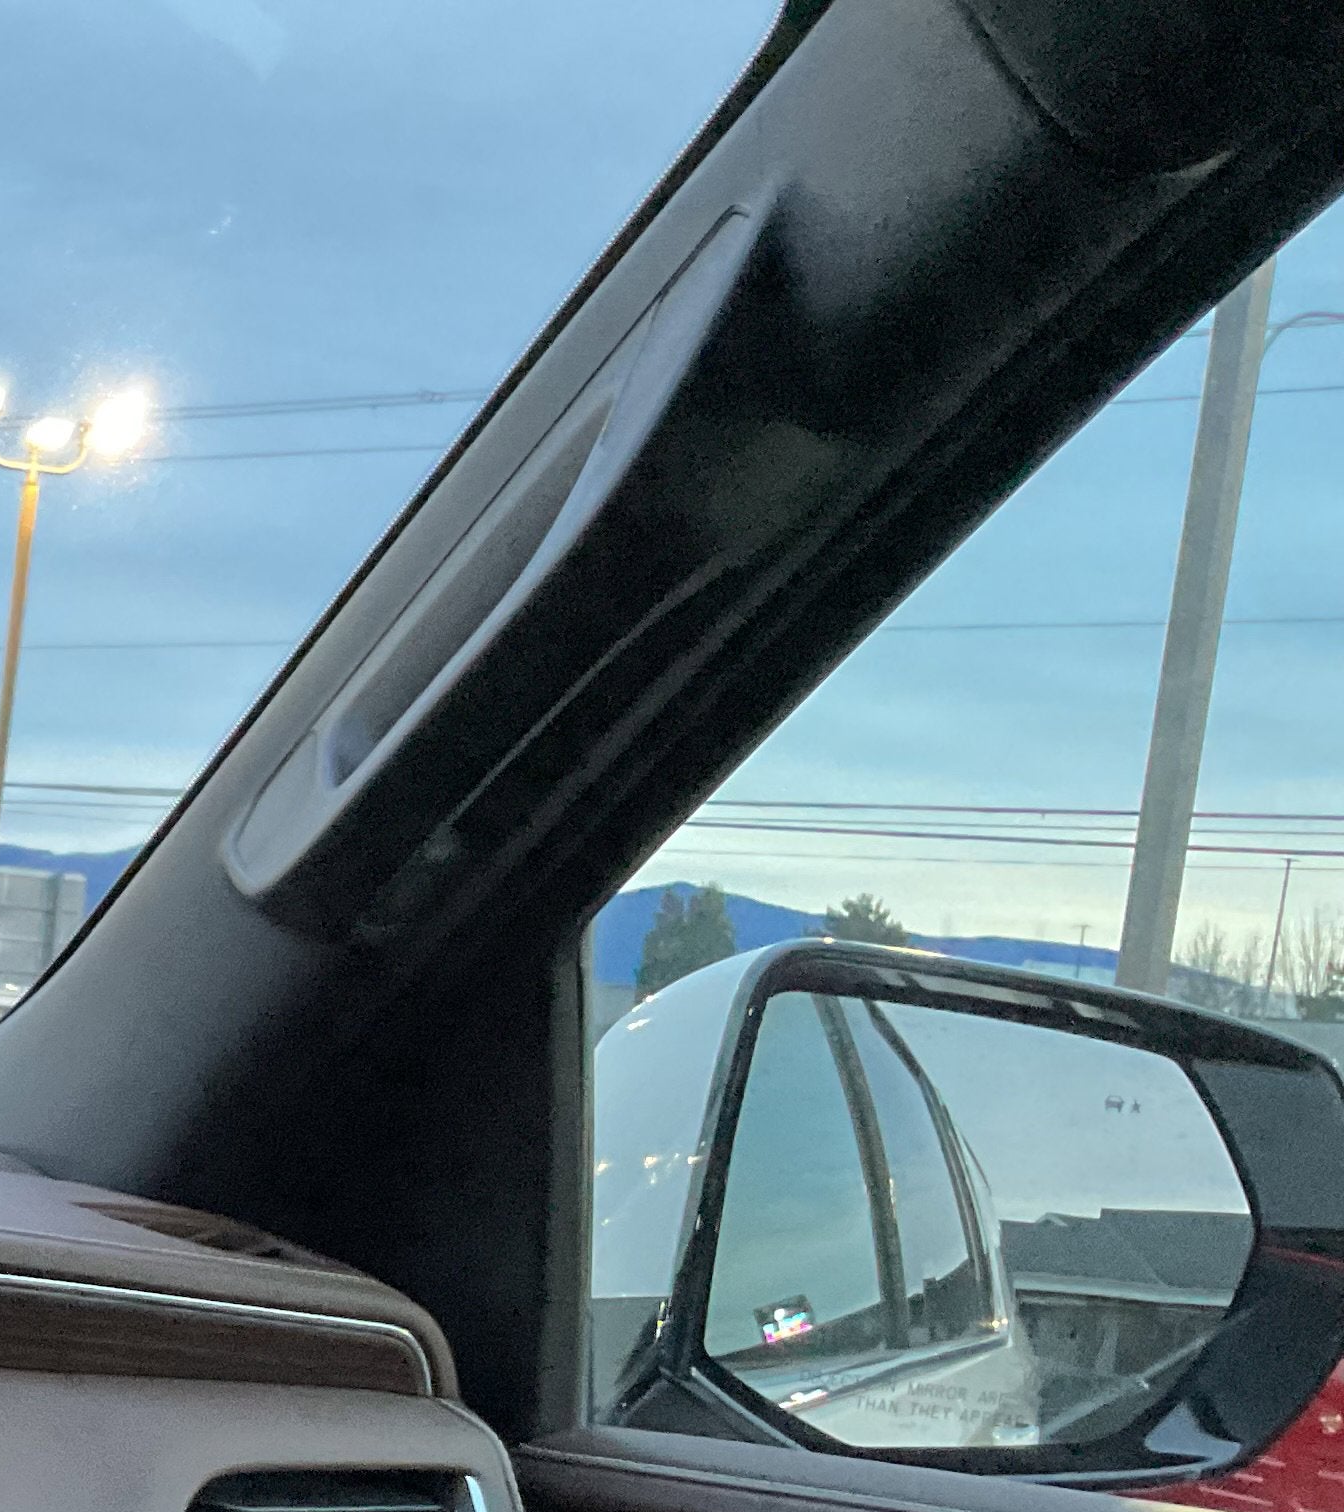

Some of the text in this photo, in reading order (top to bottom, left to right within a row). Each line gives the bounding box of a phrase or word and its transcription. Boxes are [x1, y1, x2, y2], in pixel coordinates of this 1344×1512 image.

[907, 1381, 967, 1400] MIRROR
[857, 1396, 899, 1414] THAN
[911, 1402, 952, 1420] THEY
